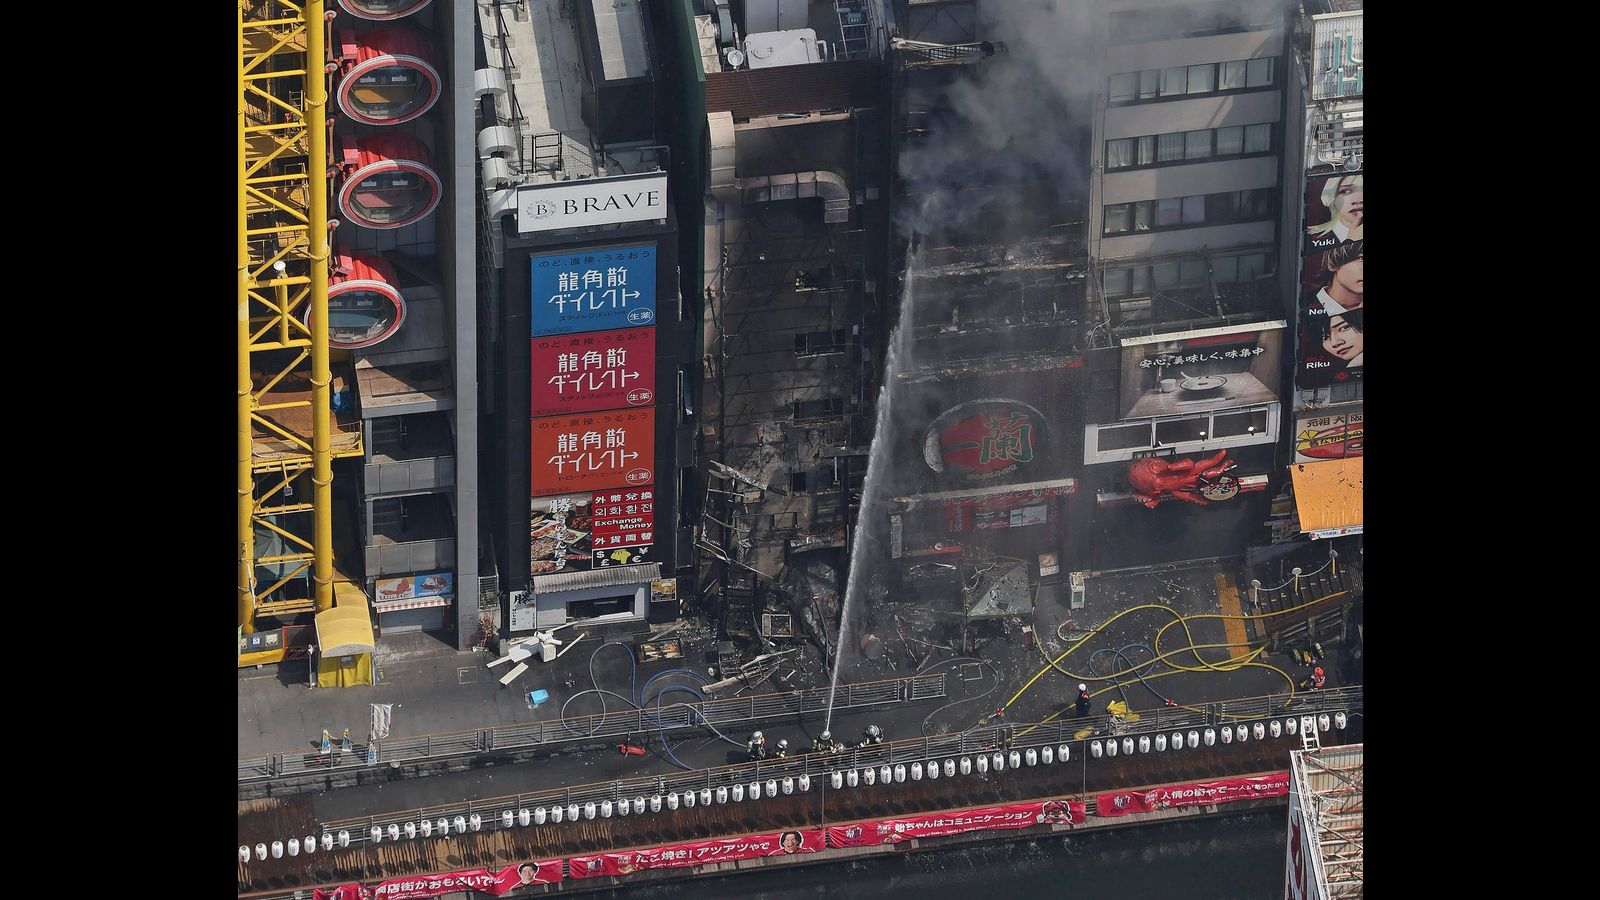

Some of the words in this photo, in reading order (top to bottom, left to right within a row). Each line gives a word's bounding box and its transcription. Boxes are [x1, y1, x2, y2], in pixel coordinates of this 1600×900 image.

[564, 190, 660, 215] BRAVE
[1312, 238, 1335, 247] Yuki
[558, 266, 628, 292] 龍角散
[548, 288, 641, 313] ダイレクト
[629, 311, 651, 321] 生薬
[558, 347, 627, 373] 龍角散
[1139, 346, 1265, 369] 安心、美味しく、味集中
[1306, 361, 1330, 369] Riku
[547, 369, 640, 394] ダイレクト
[628, 392, 650, 401] 生薬
[1306, 415, 1362, 428] 元祖大阪
[557, 427, 626, 453] 龍角散
[941, 412, 1034, 464] 一蘭
[547, 449, 639, 474] ダイレクト
[627, 472, 649, 481] 生薬
[594, 503, 653, 516] 외화환전
[594, 517, 643, 527] Exchange
[619, 522, 653, 530] Money
[639, 547, 649, 555] ¥
[600, 558, 610, 567] £
[631, 555, 641, 563] €
